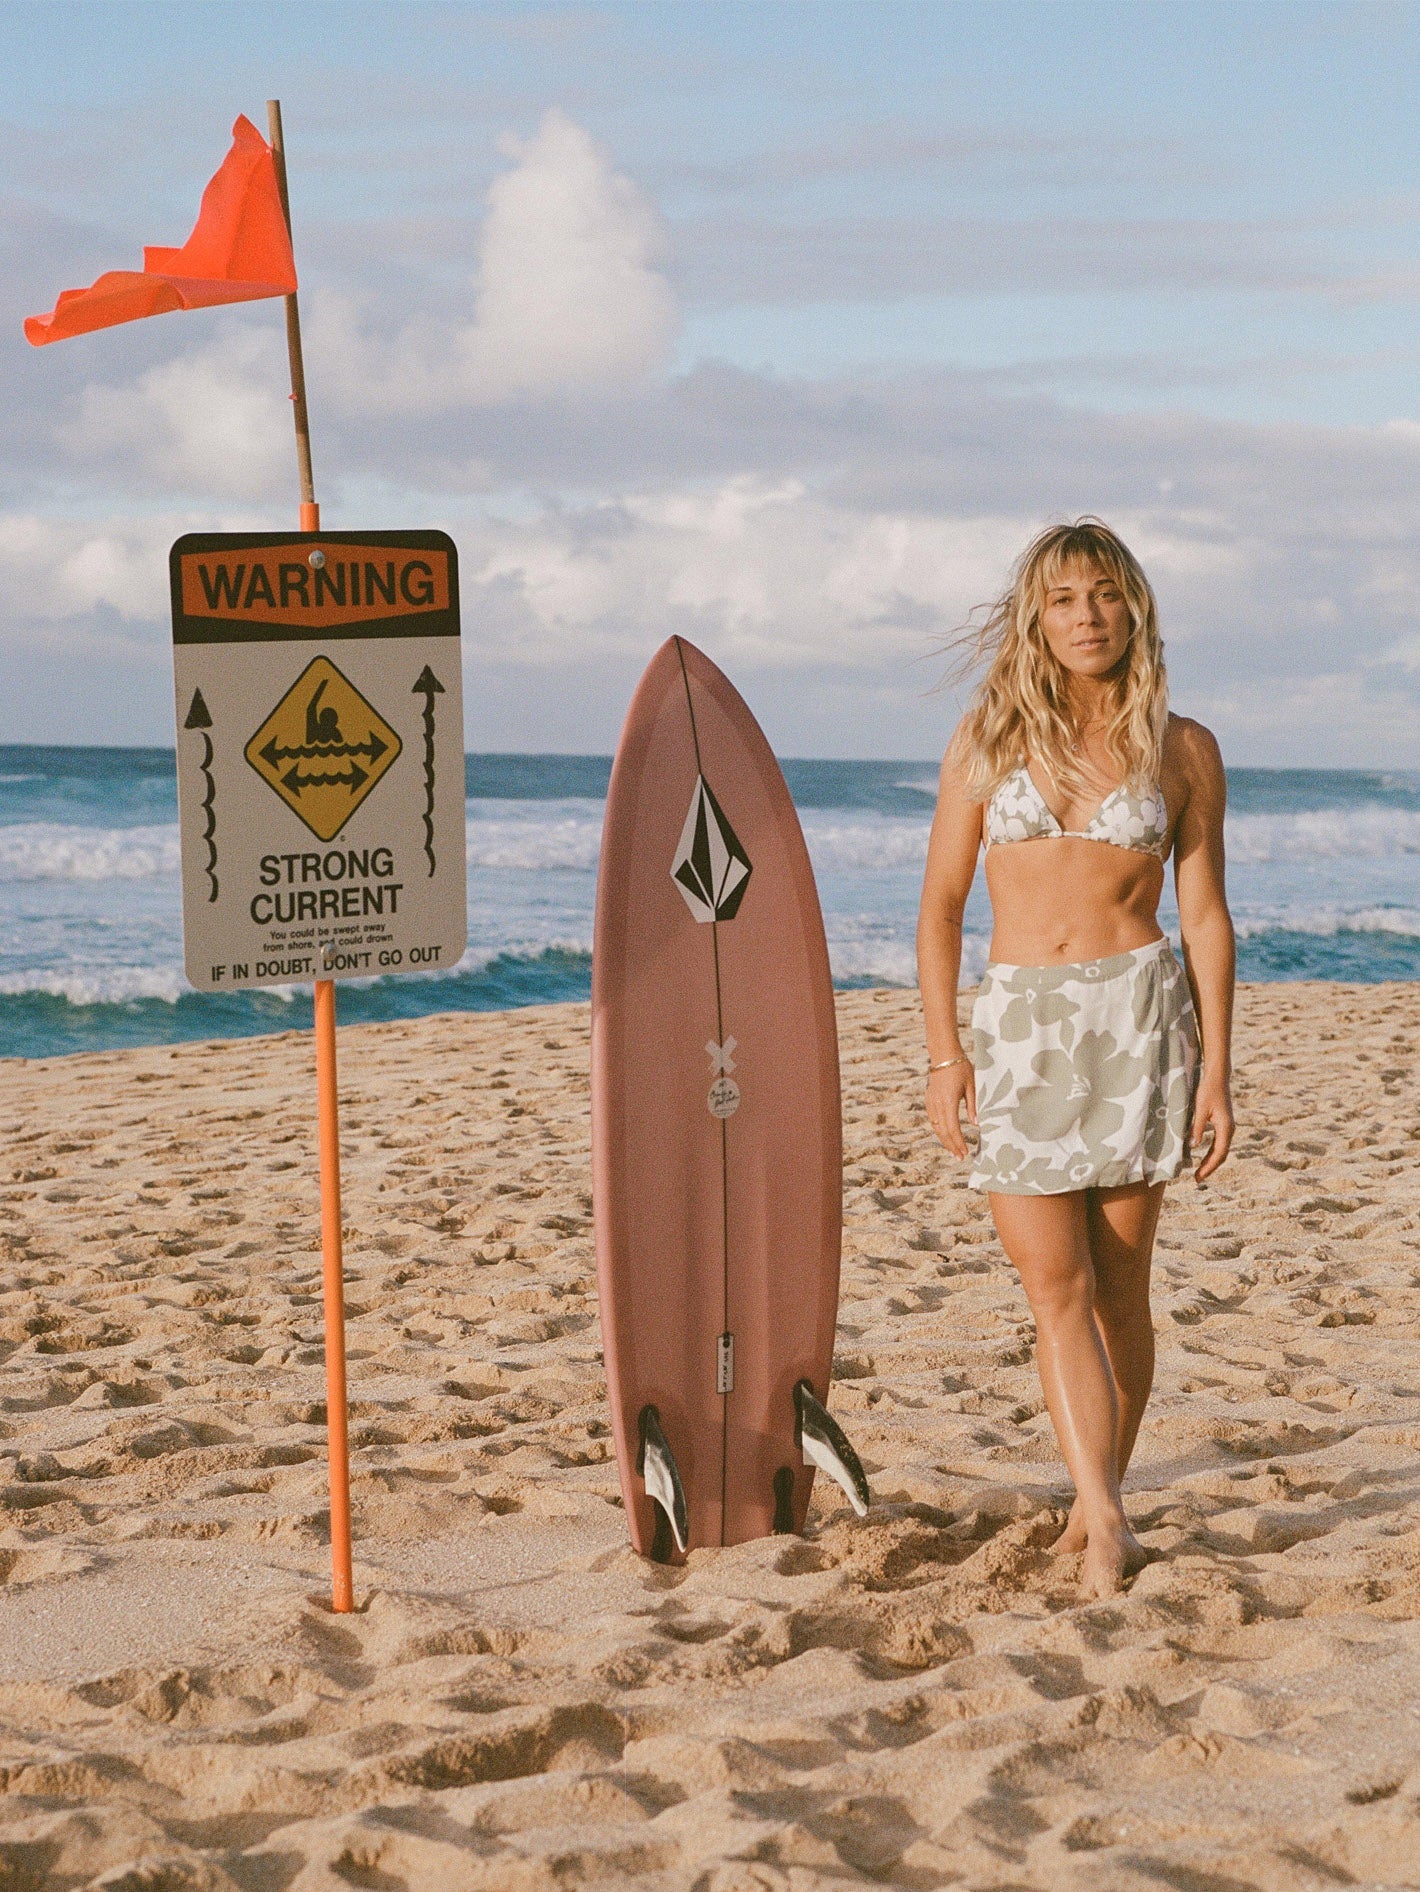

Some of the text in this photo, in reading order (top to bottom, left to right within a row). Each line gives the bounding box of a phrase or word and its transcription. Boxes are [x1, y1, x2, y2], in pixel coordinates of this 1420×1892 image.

[198, 559, 434, 609] WARNING
[259, 847, 394, 885] STRONG
[250, 884, 403, 925] CURRENT
[263, 943, 284, 952] from
[288, 941, 315, 951] shore,
[338, 935, 363, 945] could
[366, 934, 393, 943] drown
[270, 923, 386, 940] You could be swept away
[211, 946, 442, 982] IF IN DOUBT, DON'T GO OUT
